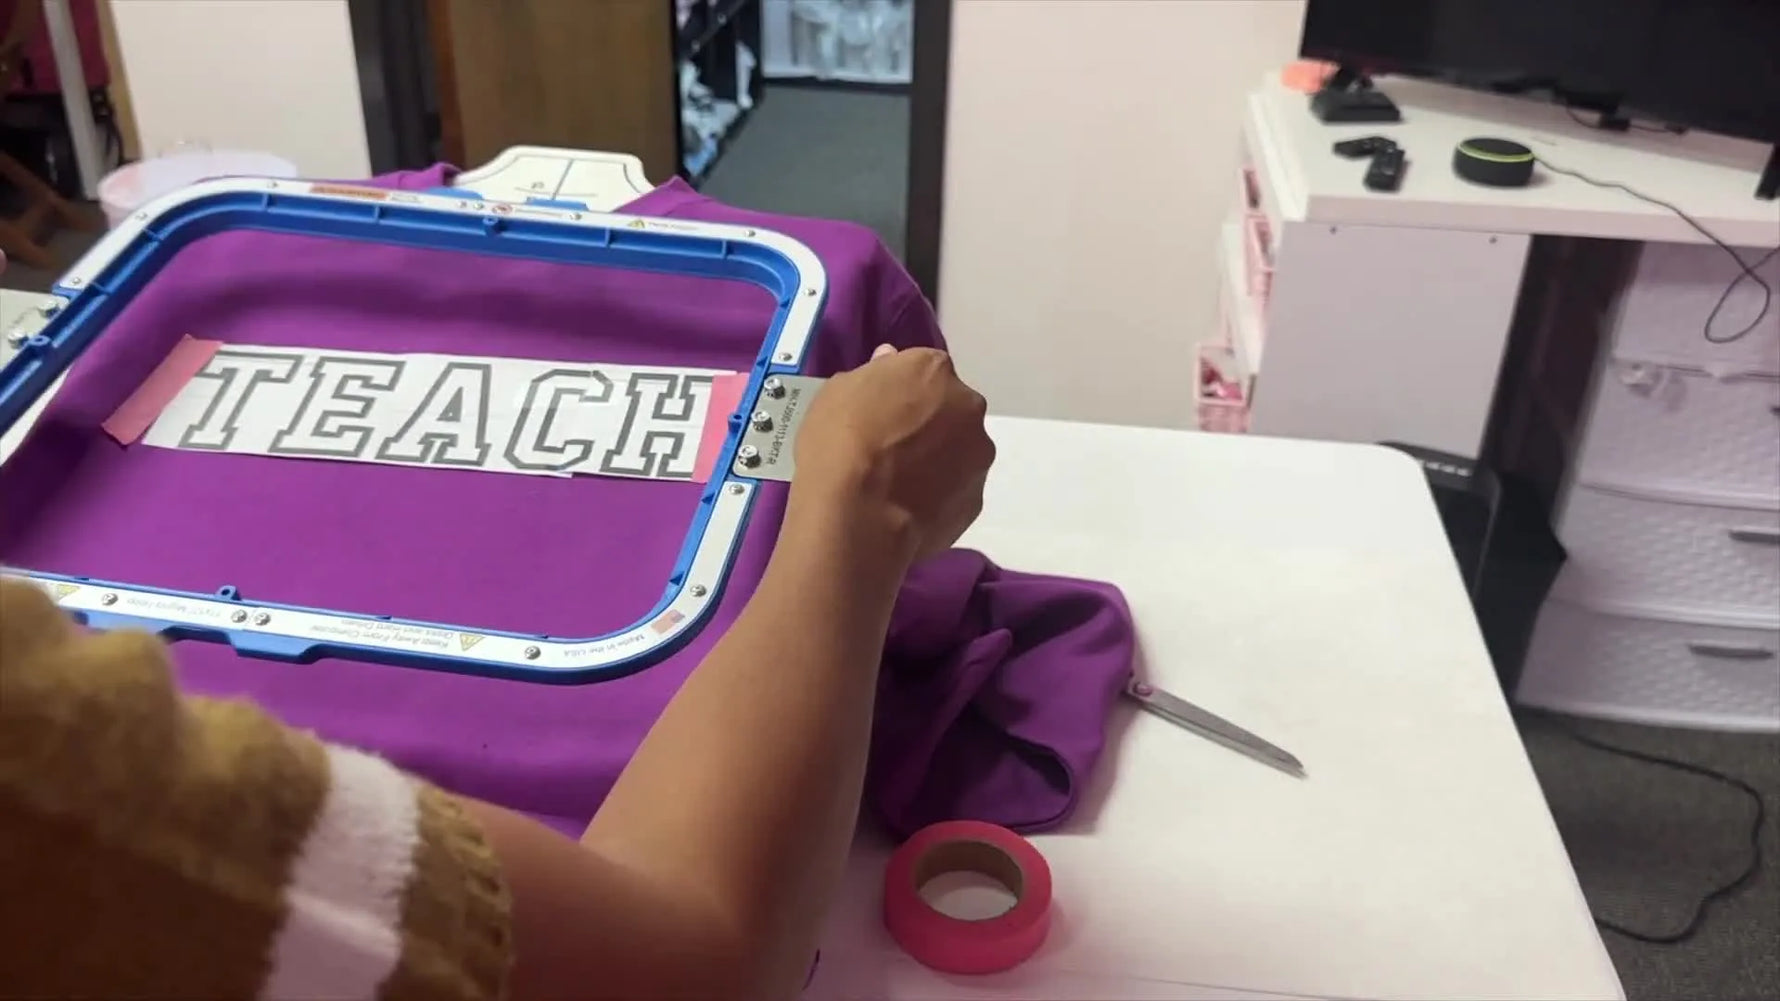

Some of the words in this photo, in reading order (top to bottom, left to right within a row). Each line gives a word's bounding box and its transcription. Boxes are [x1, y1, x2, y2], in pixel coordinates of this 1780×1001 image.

[179, 350, 714, 478] TEACH
[363, 631, 391, 642] From
[393, 634, 420, 646] Away
[618, 634, 645, 646] Made
